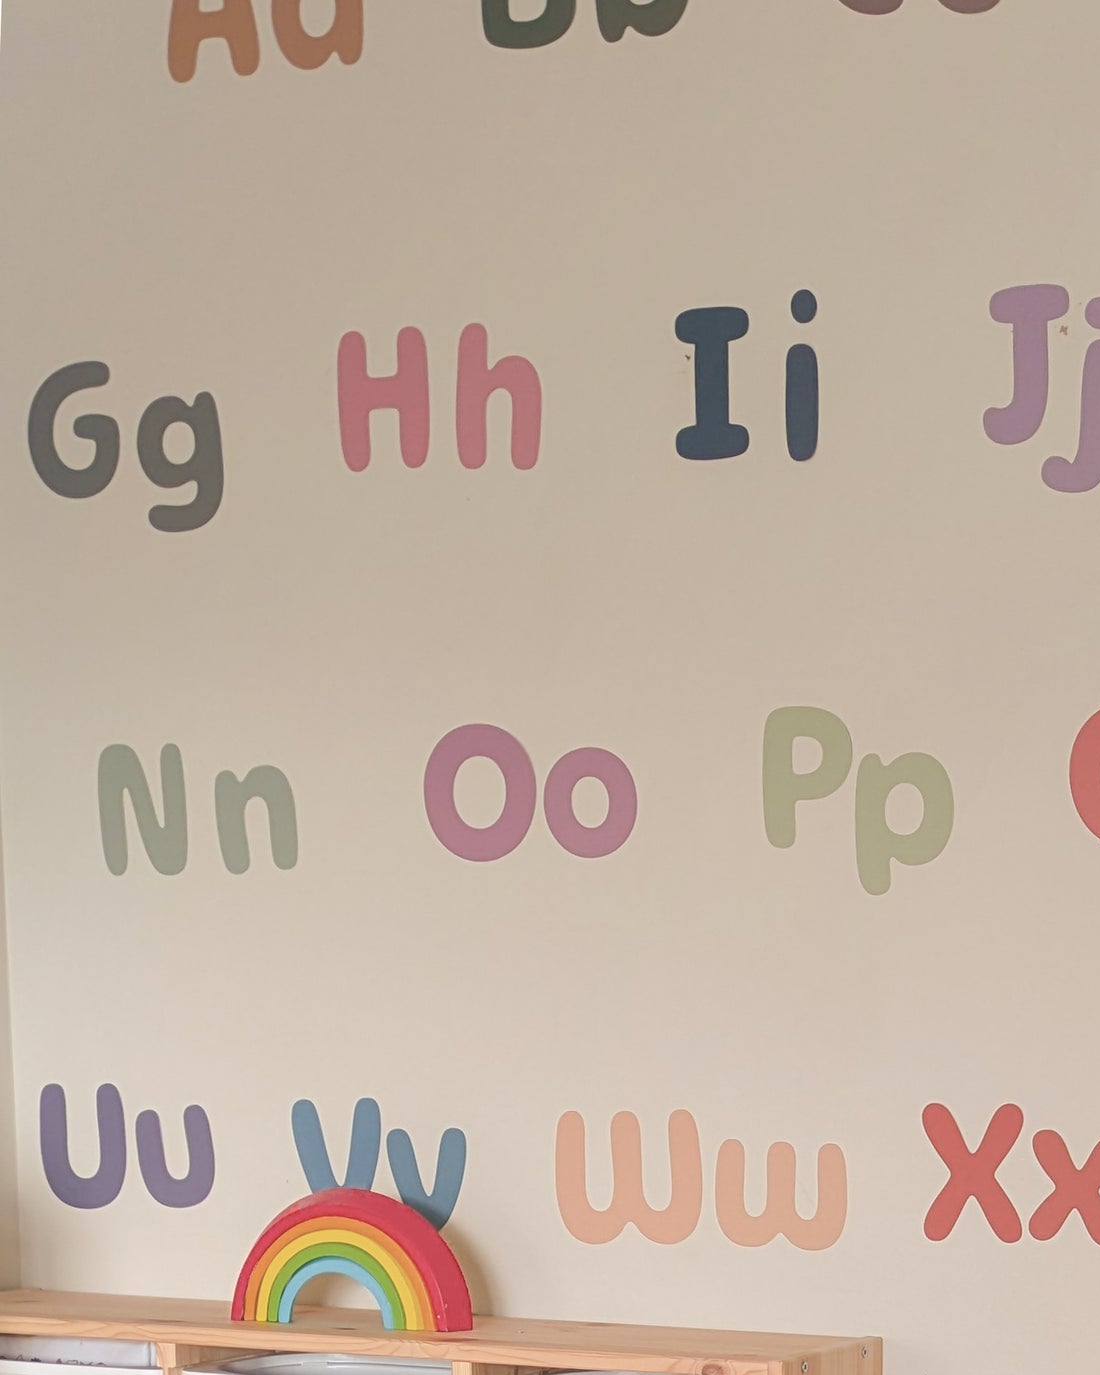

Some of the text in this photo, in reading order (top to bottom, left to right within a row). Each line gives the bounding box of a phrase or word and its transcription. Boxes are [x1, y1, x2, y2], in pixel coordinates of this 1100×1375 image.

[27, 361, 224, 533] Gg
[337, 323, 542, 472] Hh
[674, 288, 819, 462] Ii
[98, 744, 298, 876] Nn
[424, 724, 637, 862] Oo
[763, 706, 954, 895] Pp
[40, 1083, 215, 1209] Uu
[292, 1098, 467, 1231] Vv
[556, 1109, 847, 1251] Ww
